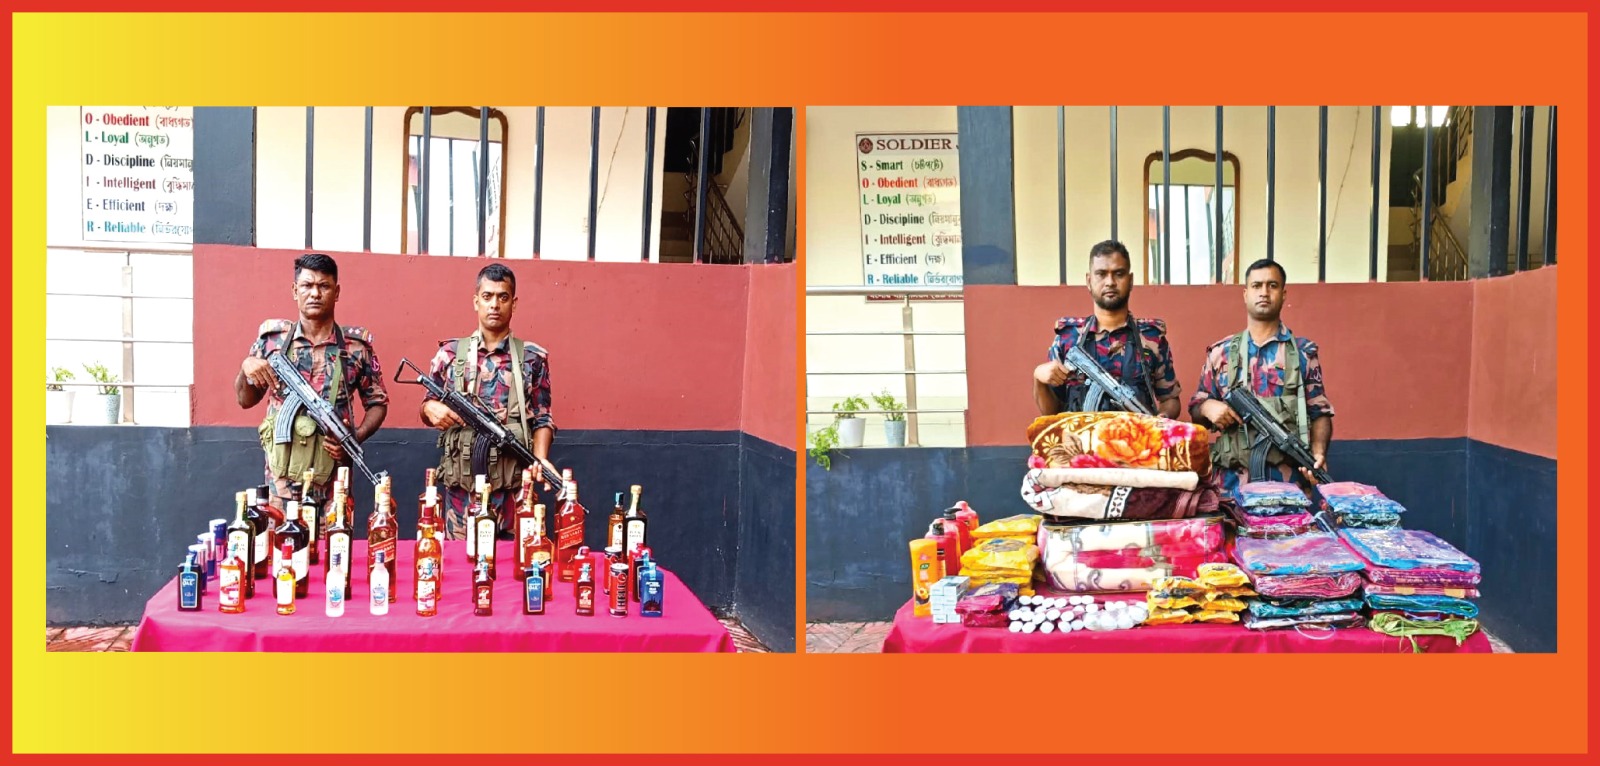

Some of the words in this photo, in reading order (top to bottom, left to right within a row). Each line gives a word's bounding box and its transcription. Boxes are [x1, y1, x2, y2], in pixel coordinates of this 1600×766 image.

[85, 112, 92, 124] O
[103, 113, 150, 126] Obedient
[85, 131, 92, 142] L
[102, 131, 129, 146] Loyal
[877, 138, 952, 150] SOLDIER
[86, 154, 93, 165] D
[104, 154, 155, 168] Discipline
[862, 160, 867, 171] S
[876, 160, 903, 170] Smart
[86, 176, 89, 187] I
[103, 176, 156, 191] Intelligent
[862, 178, 869, 188] O
[878, 177, 918, 188] Obedient
[87, 198, 92, 210] E
[103, 199, 145, 211] Efficient
[863, 194, 868, 205] L
[877, 194, 901, 207] Loyal
[864, 214, 870, 225] D
[880, 214, 924, 226] Discipline
[87, 221, 94, 232] R
[104, 221, 146, 233] Reliable
[865, 235, 868, 245] I
[880, 234, 926, 246] Intelligent
[866, 254, 872, 264] E
[880, 254, 917, 264] Efficient
[868, 274, 874, 284] R
[883, 274, 918, 285] Reliable
